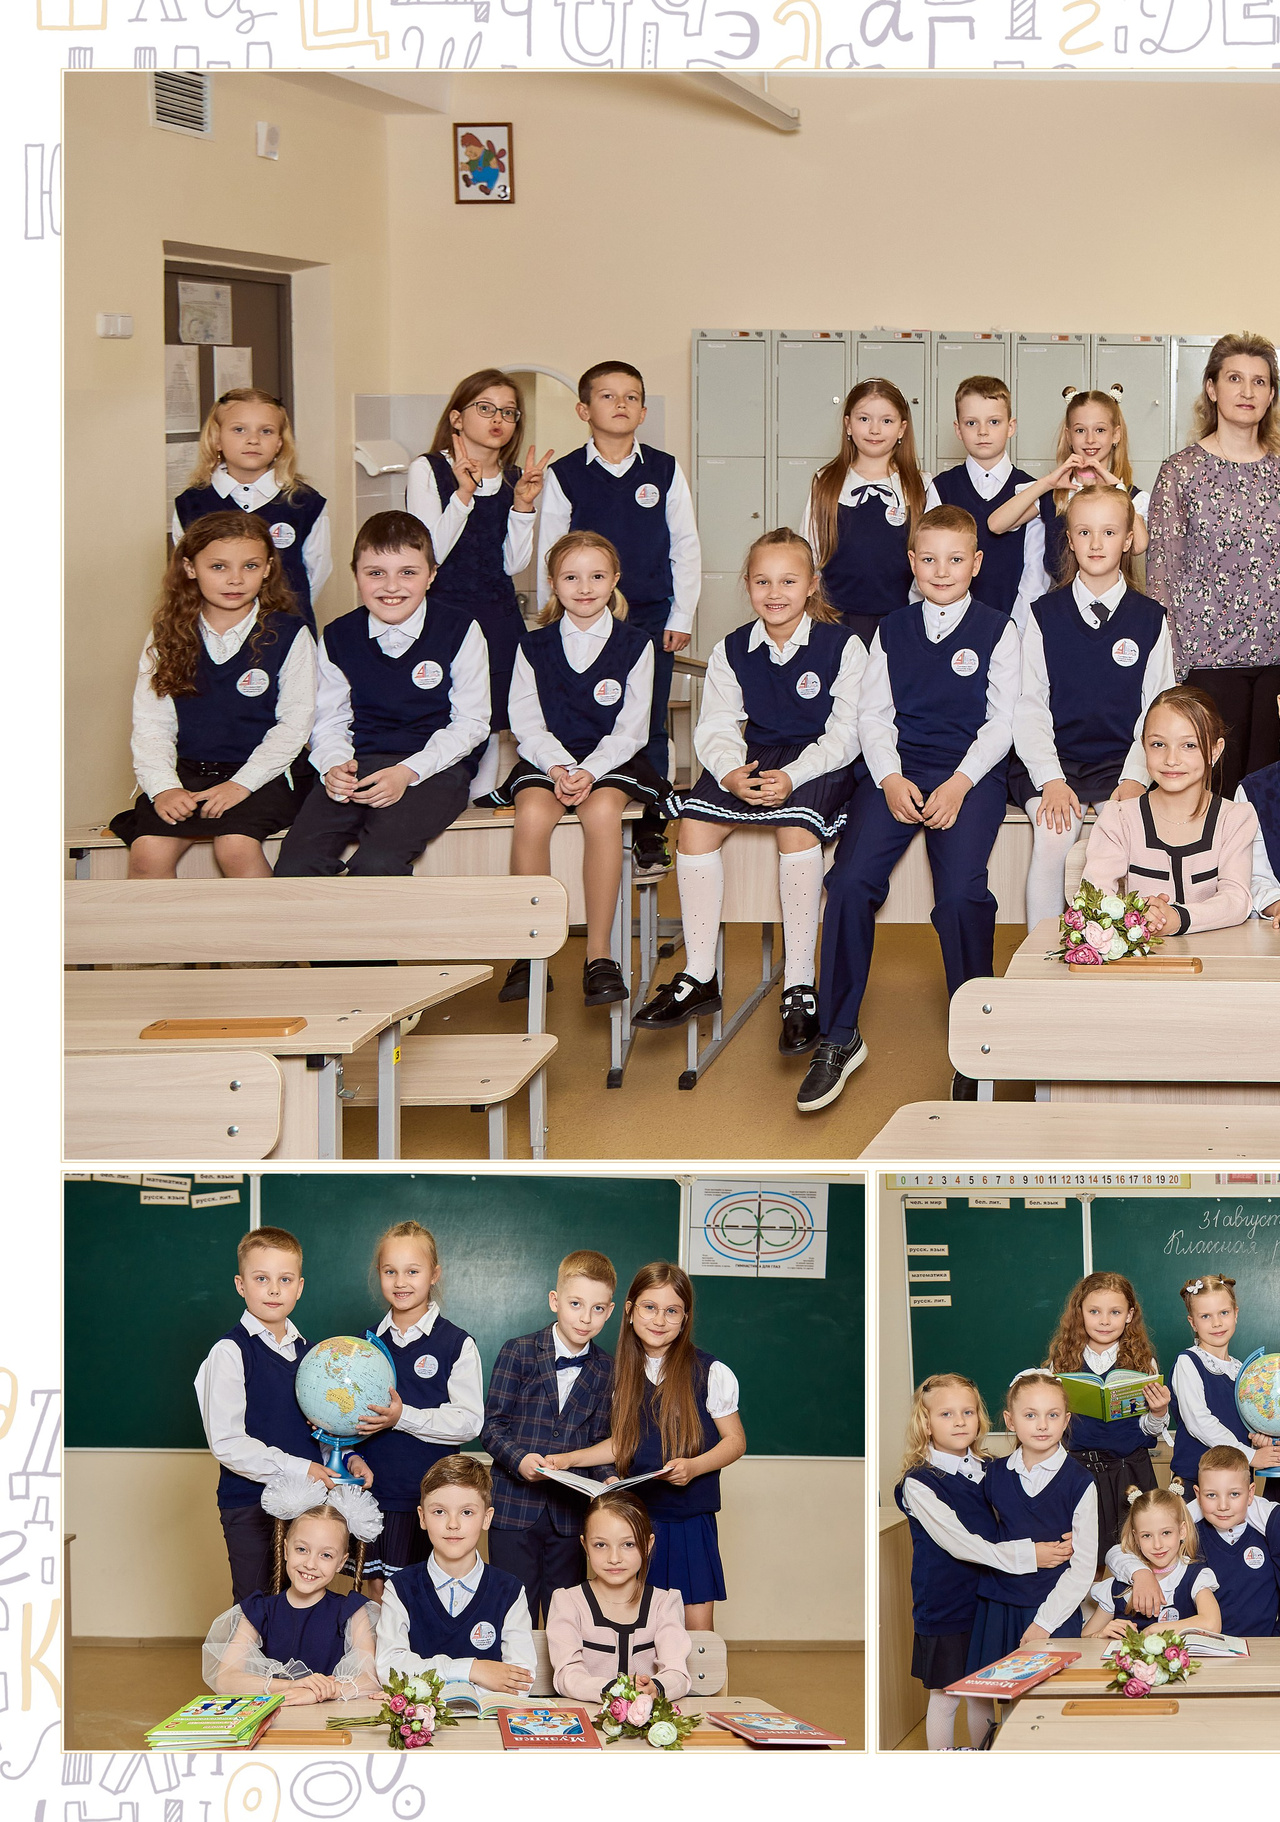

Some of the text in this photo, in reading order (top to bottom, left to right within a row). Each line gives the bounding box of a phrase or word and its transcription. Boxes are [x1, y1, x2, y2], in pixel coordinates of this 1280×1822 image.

[498, 184, 508, 198] 3
[146, 1177, 188, 1186] математика
[900, 1175, 1179, 1184] 0 1 2 3 4 5 6 7 8 9 10 11 12 13 14 15 16 17 18 19 20
[195, 1196, 217, 1204] русск.
[1198, 1210, 1220, 1230] 31
[965, 1679, 1018, 1688] Музыка
